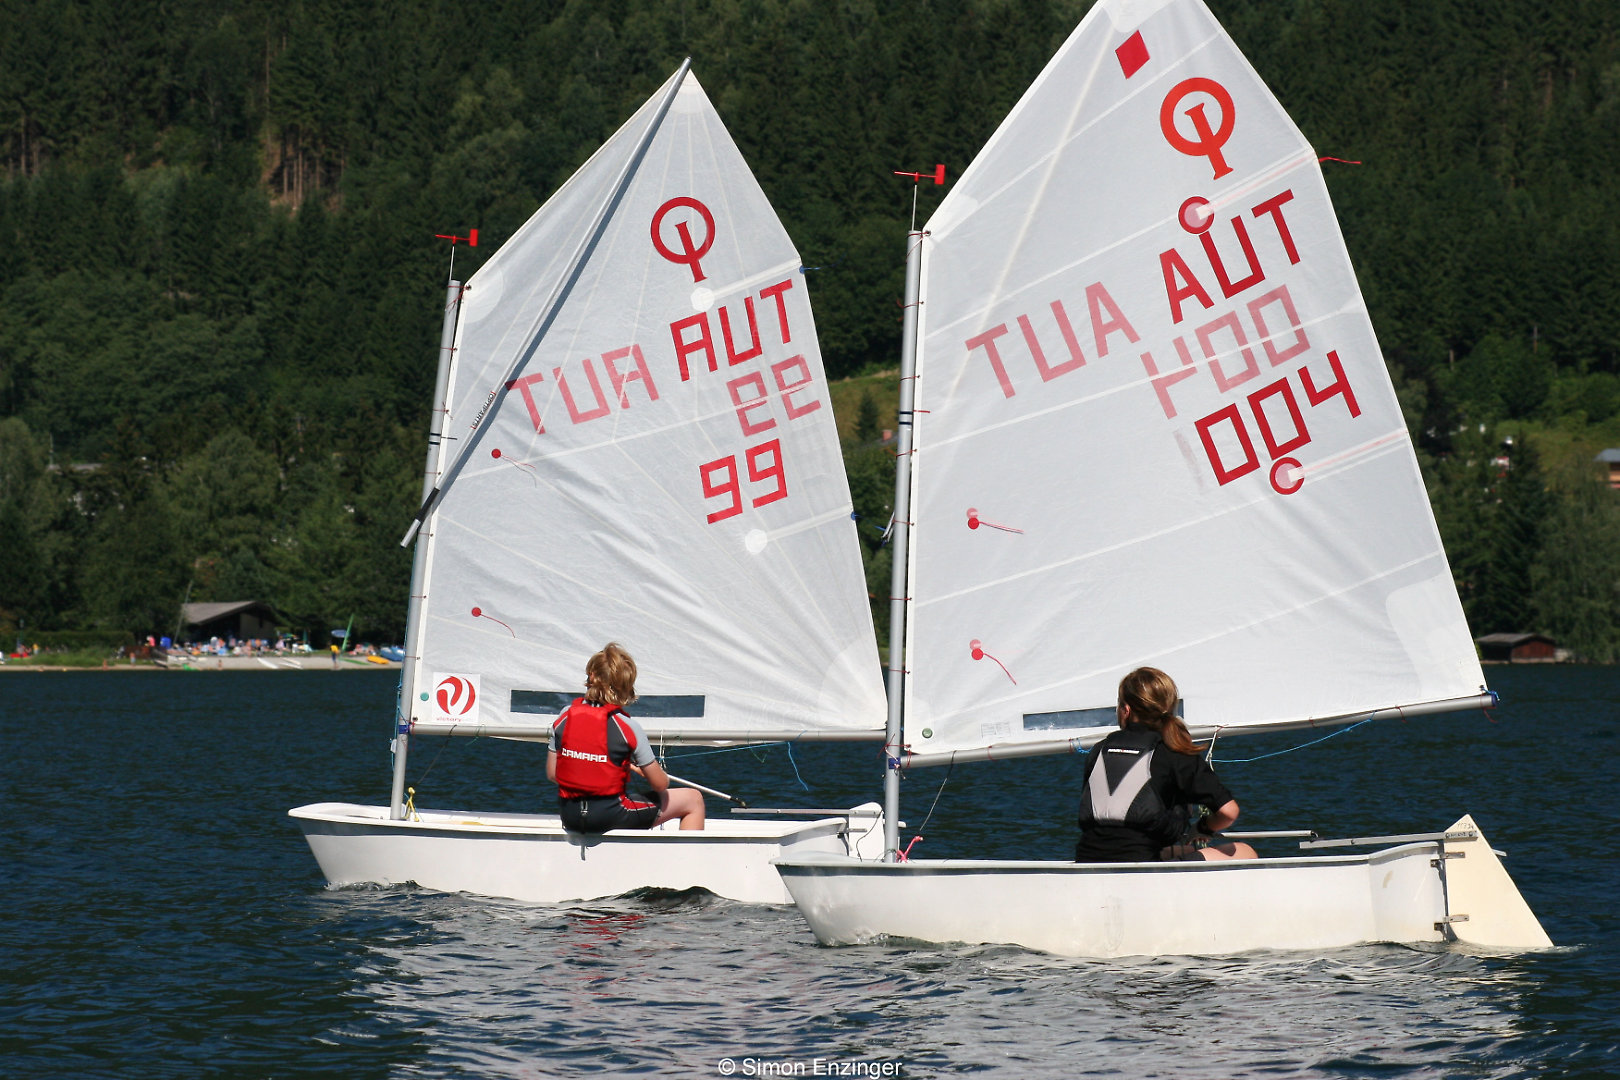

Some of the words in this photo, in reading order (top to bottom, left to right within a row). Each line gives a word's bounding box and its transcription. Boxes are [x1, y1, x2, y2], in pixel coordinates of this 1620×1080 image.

[1159, 189, 1302, 325] AUT
[670, 278, 794, 383] AUT
[1194, 350, 1362, 487] 004
[699, 438, 789, 526] 99
[561, 748, 608, 763] CAMARO
